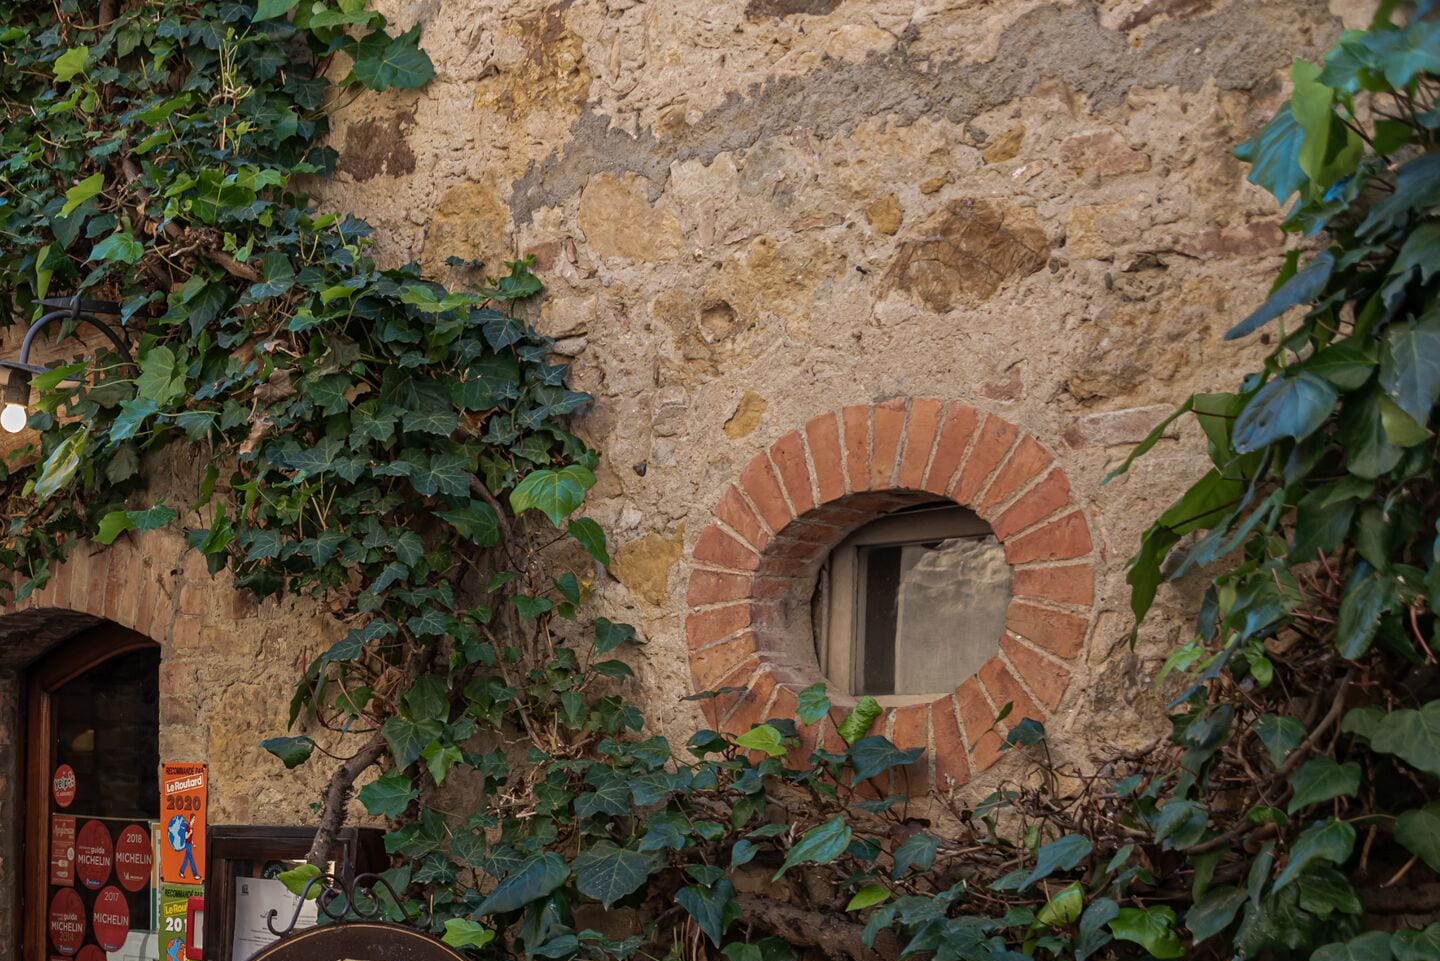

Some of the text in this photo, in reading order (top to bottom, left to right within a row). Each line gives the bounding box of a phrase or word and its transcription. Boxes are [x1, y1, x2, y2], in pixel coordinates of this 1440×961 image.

[174, 775, 202, 791] Routard
[166, 795, 201, 811] 2020
[126, 833, 143, 844] 2018
[77, 855, 111, 866] MICHELIN
[115, 852, 152, 865] MICHELIN
[93, 912, 129, 926] MICHELIN
[51, 921, 83, 933] MICHELIN
